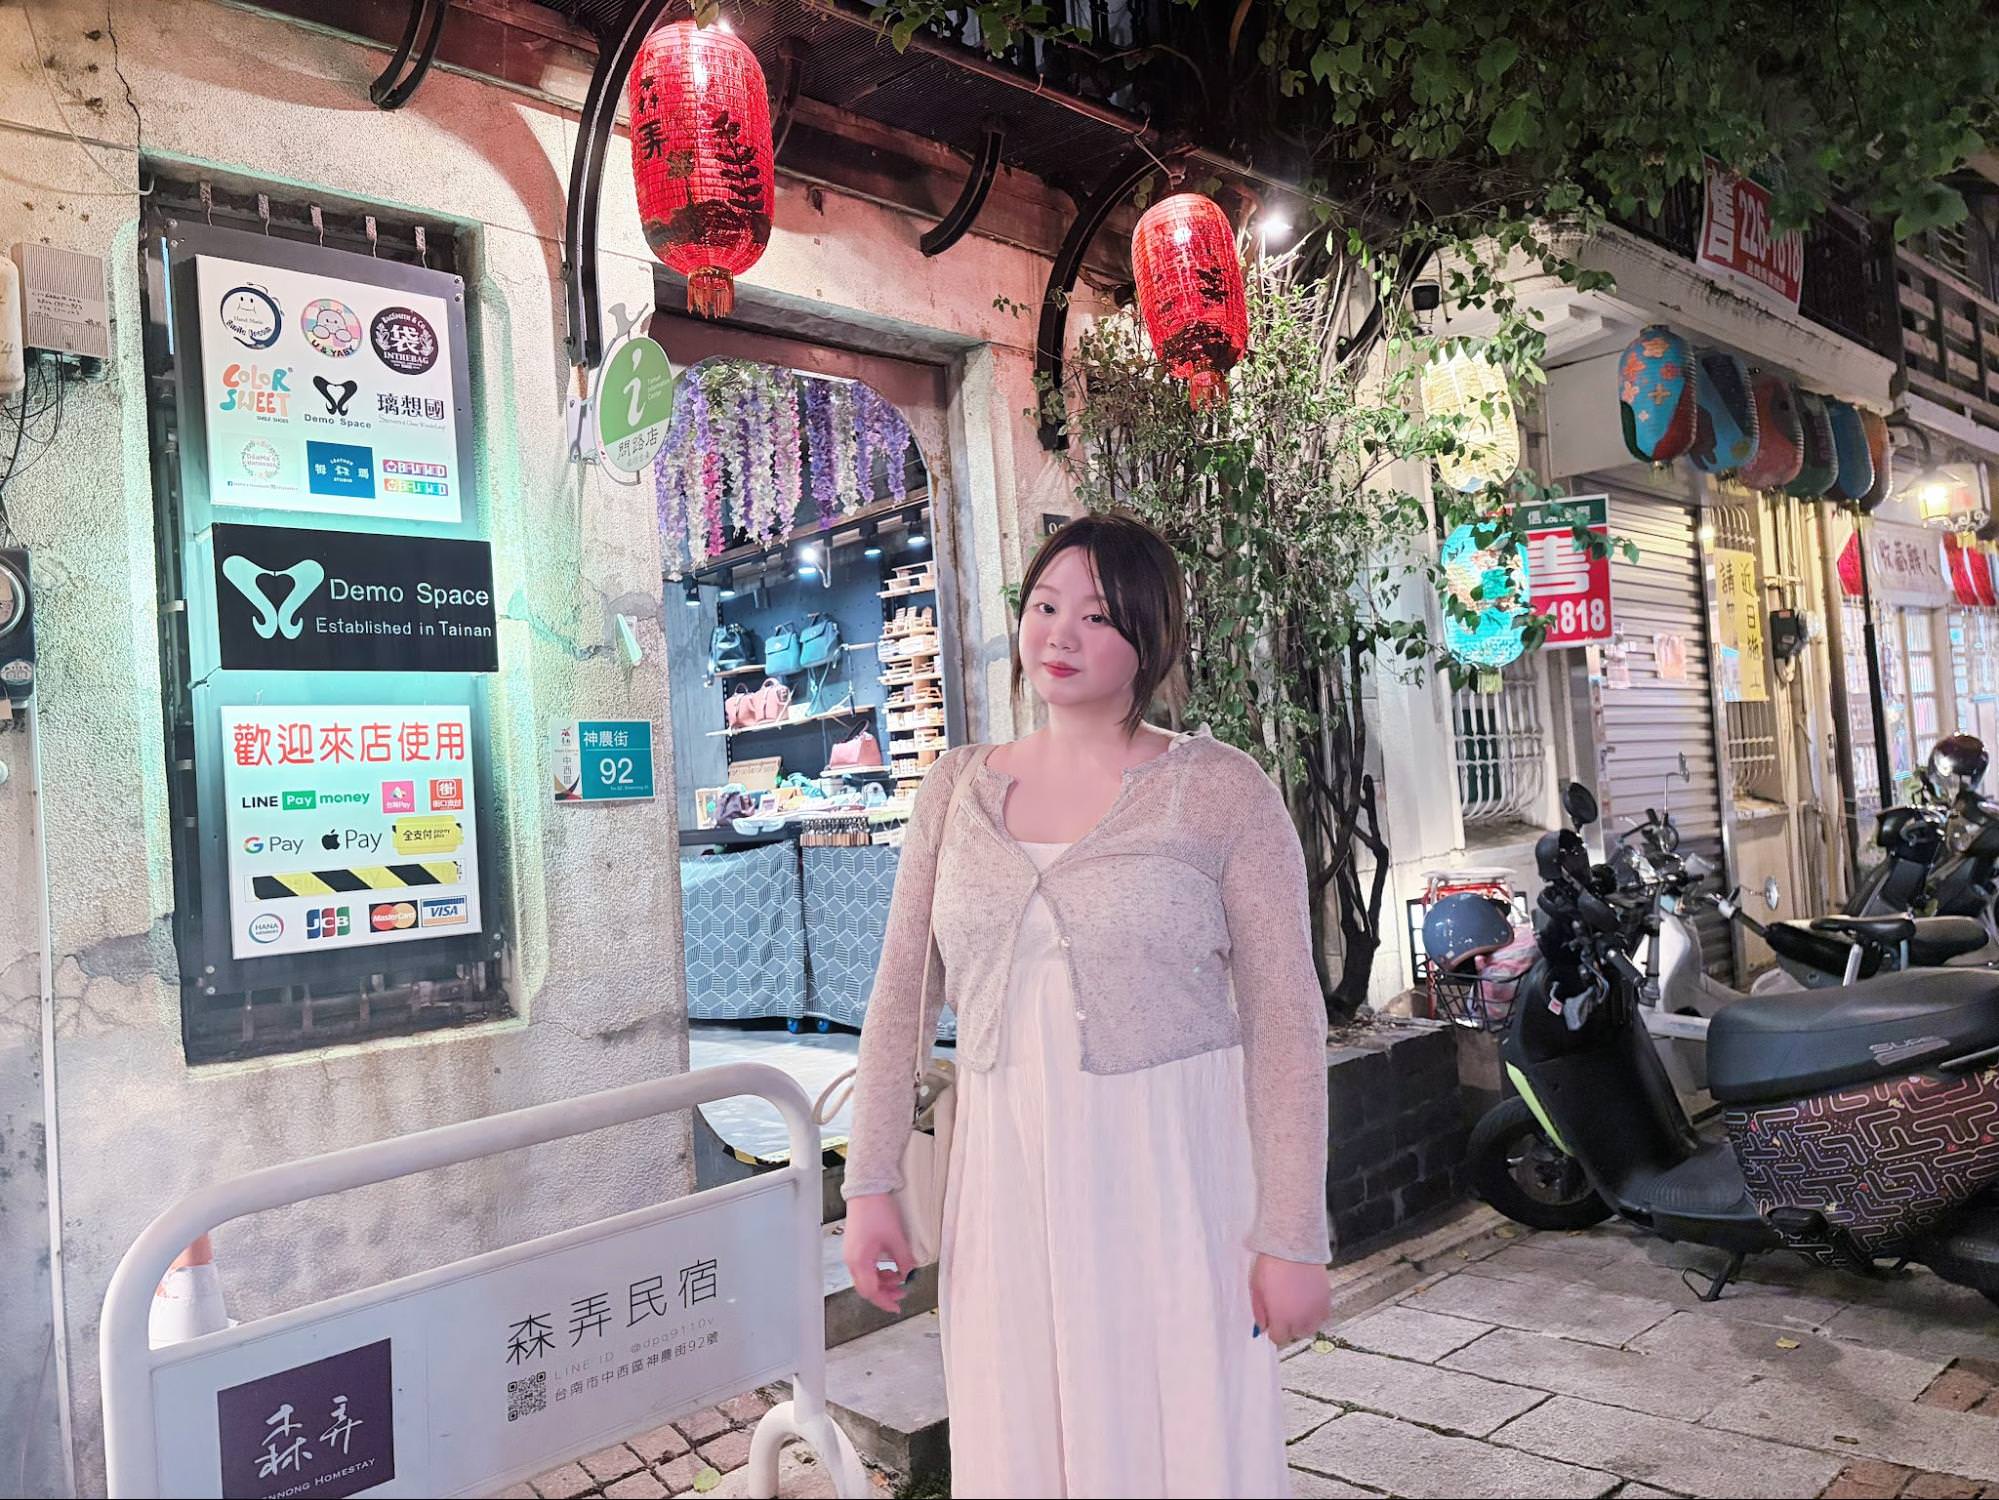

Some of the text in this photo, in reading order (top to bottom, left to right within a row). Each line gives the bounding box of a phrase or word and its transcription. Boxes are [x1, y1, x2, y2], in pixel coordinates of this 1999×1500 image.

[390, 324, 420, 354] 袋
[219, 388, 289, 417] SWEET
[376, 393, 445, 421] 璃想國
[304, 414, 335, 425] Demo
[340, 417, 372, 430] Space
[330, 578, 489, 609] Demo Space
[316, 617, 492, 637] Established in Tainan
[232, 722, 465, 767] 歡迎來店使用
[583, 729, 629, 748] 神農街
[599, 757, 634, 786] 92
[242, 793, 370, 808] LINE Pay money
[269, 836, 305, 854] Pay
[345, 829, 383, 853] Pay
[403, 829, 432, 842] 全支付
[372, 911, 416, 922] MasterCard
[430, 905, 458, 917] VISA
[506, 1259, 718, 1366] 森弄民宿
[554, 1359, 592, 1381] LINE
[314, 1458, 376, 1487] HOMESTAY
